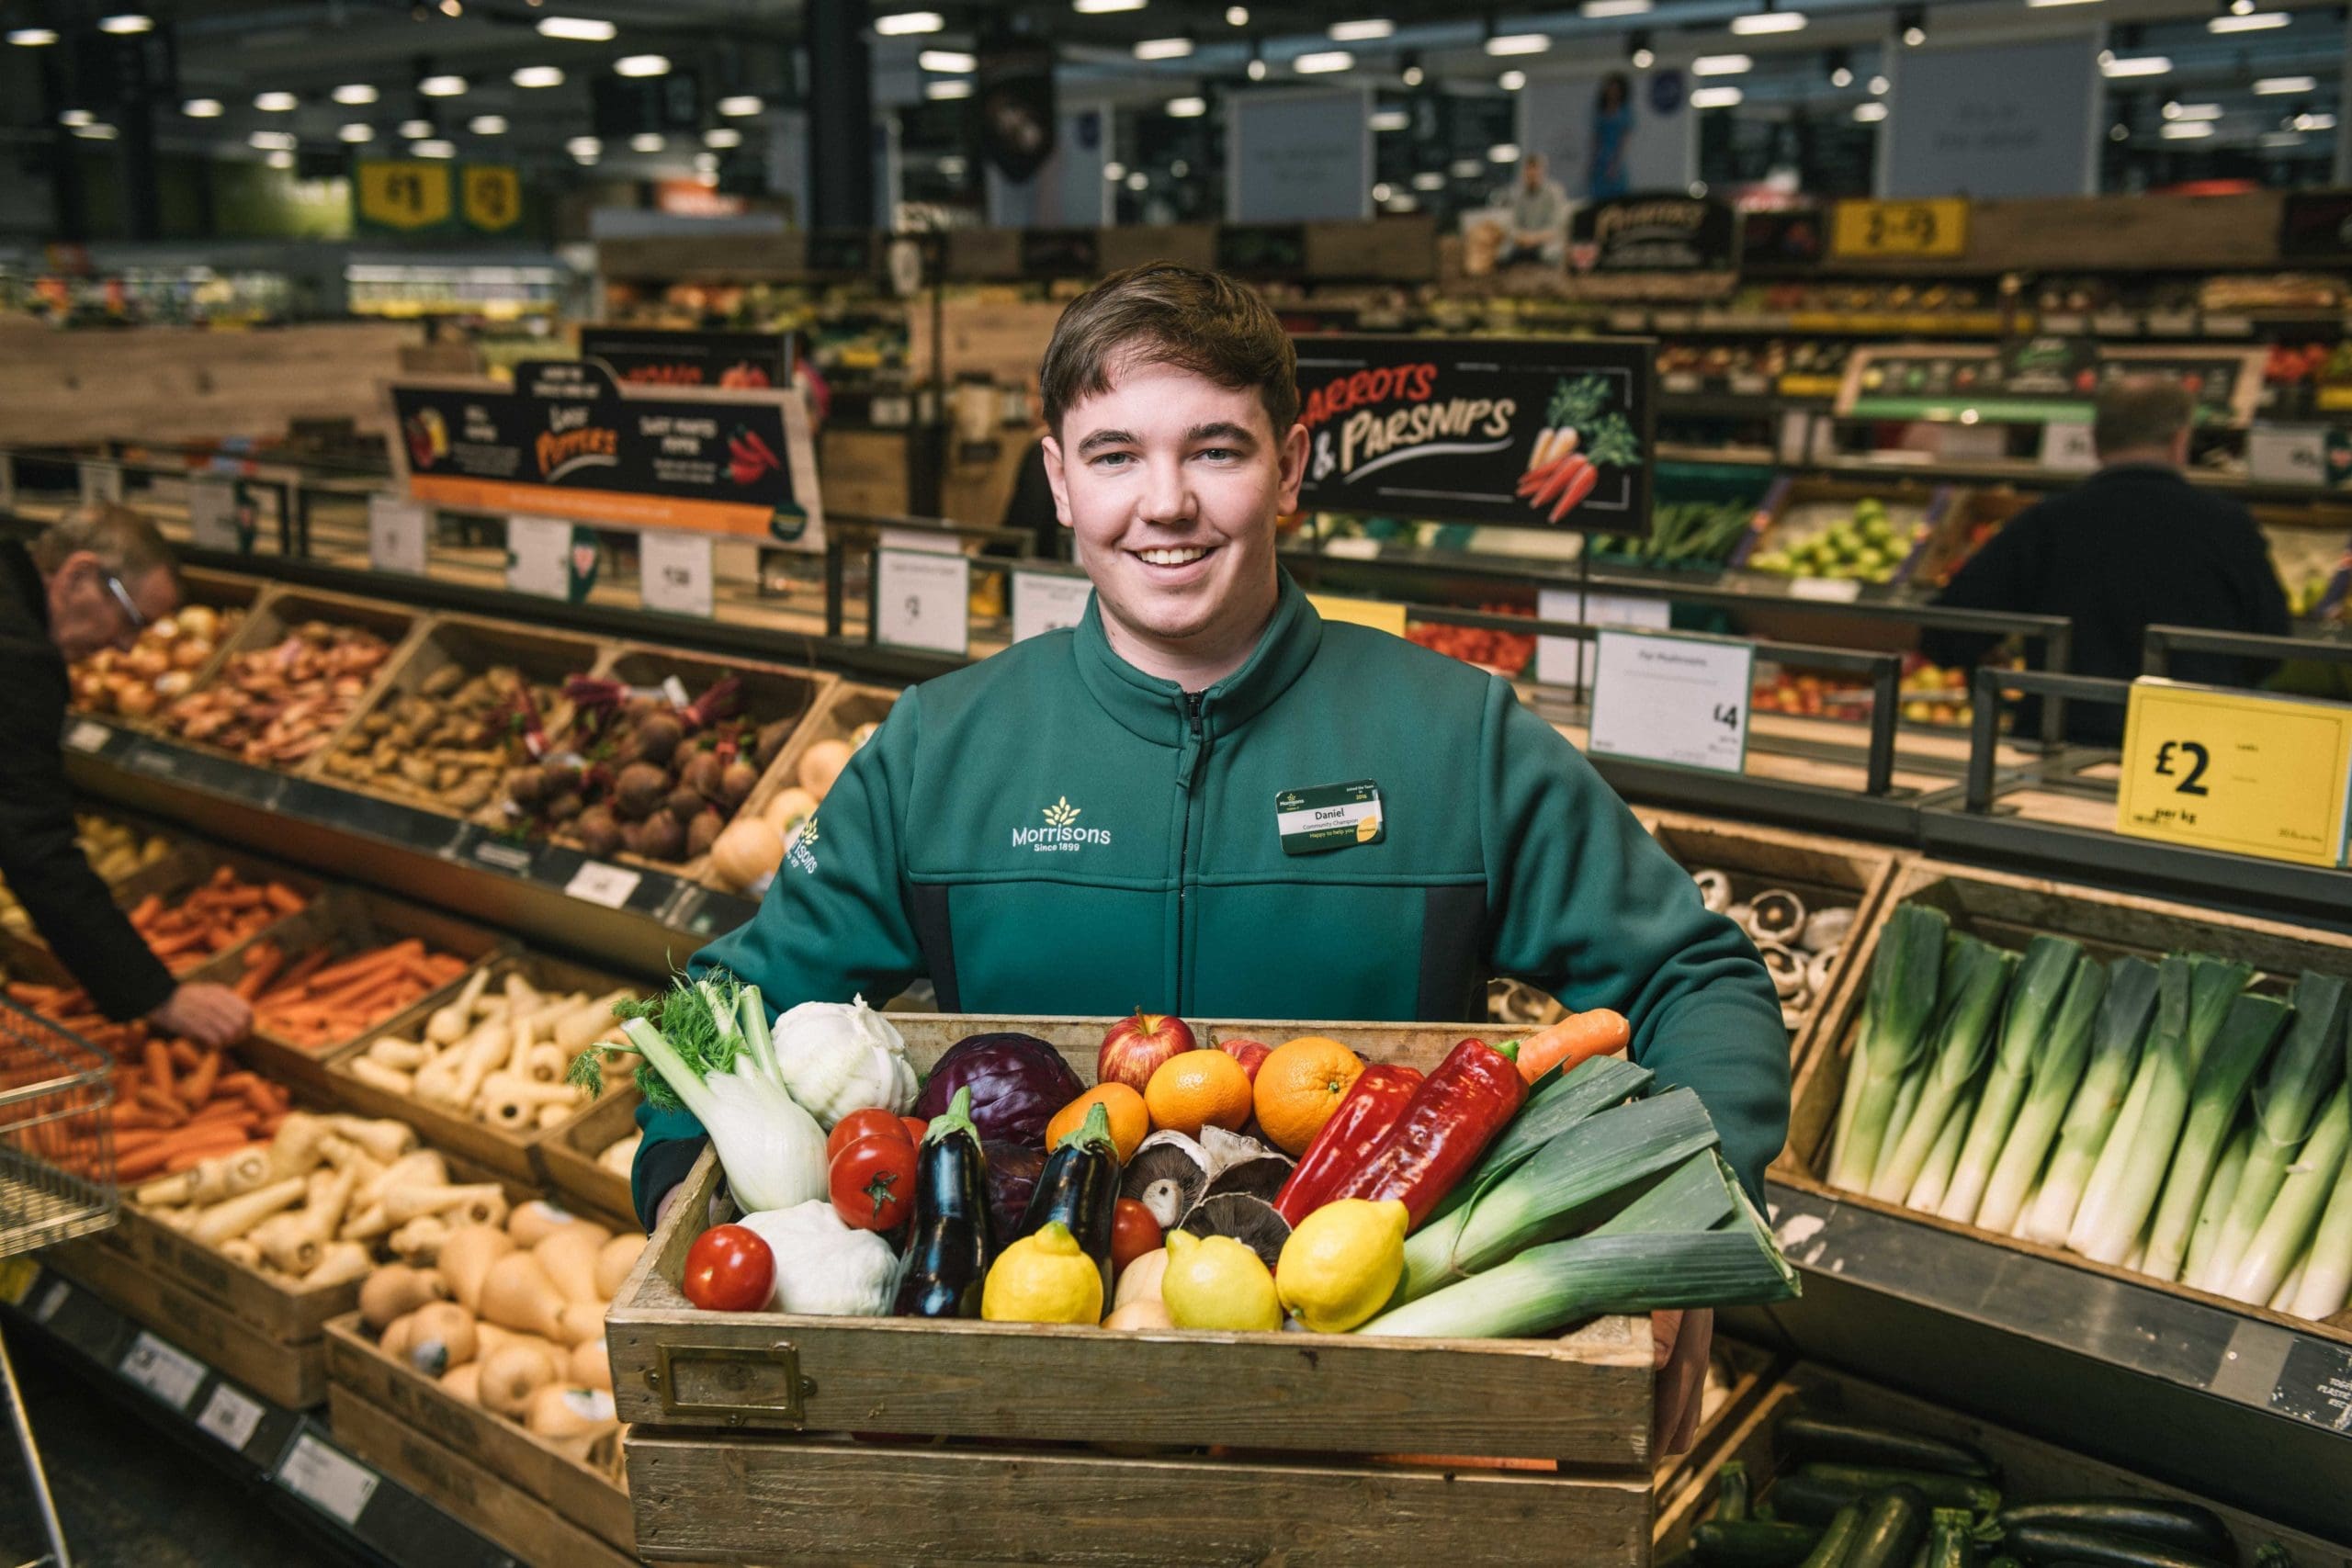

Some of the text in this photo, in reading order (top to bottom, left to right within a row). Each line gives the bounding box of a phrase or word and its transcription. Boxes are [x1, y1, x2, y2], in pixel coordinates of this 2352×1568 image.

[1296, 363, 1438, 428] ARROTS
[1312, 398, 1517, 480] & PARSNIPS
[2154, 740, 2210, 797] £2
[1303, 821, 1332, 830] Community
[1315, 807, 1345, 820] Daniel
[1012, 823, 1111, 847] Morrisons
[1034, 842, 1080, 852] Since 1899
